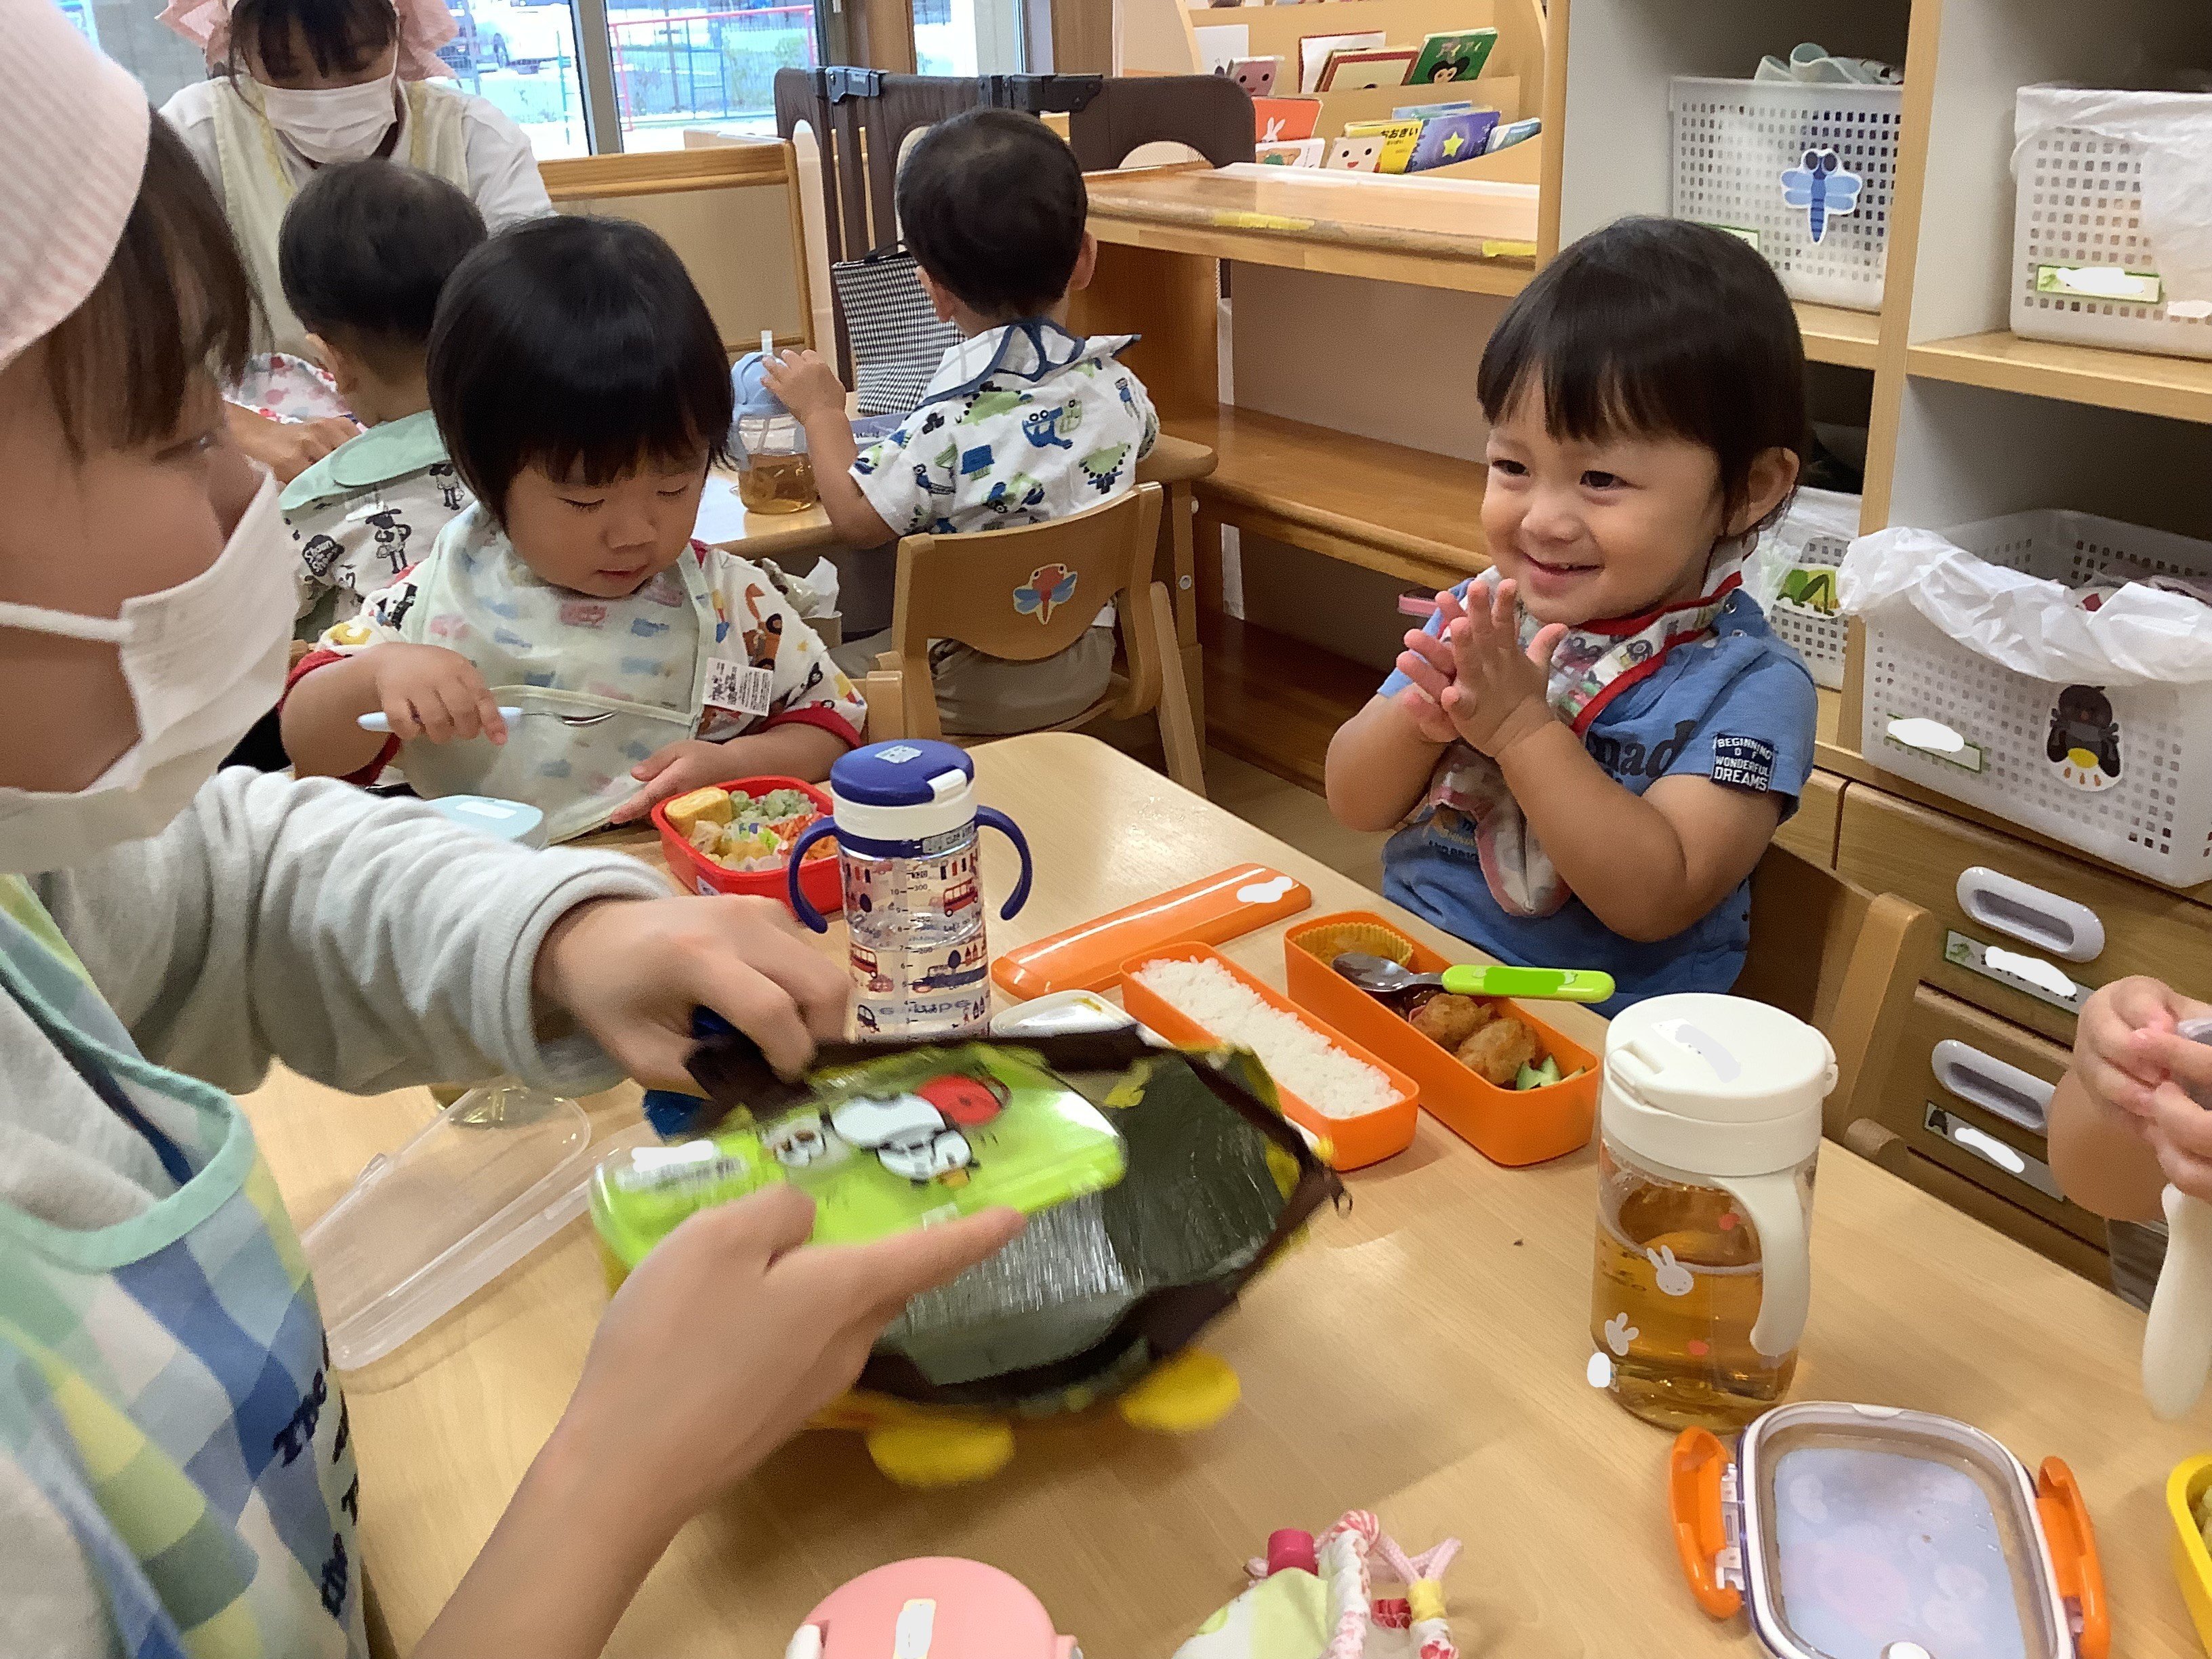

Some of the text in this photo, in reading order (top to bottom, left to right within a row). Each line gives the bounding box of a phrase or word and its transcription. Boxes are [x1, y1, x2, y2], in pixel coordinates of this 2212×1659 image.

[1717, 737, 1773, 760] BEGINNING
[1715, 756, 1770, 777] WONDERFUL
[1714, 766, 1768, 792] DREAMS
